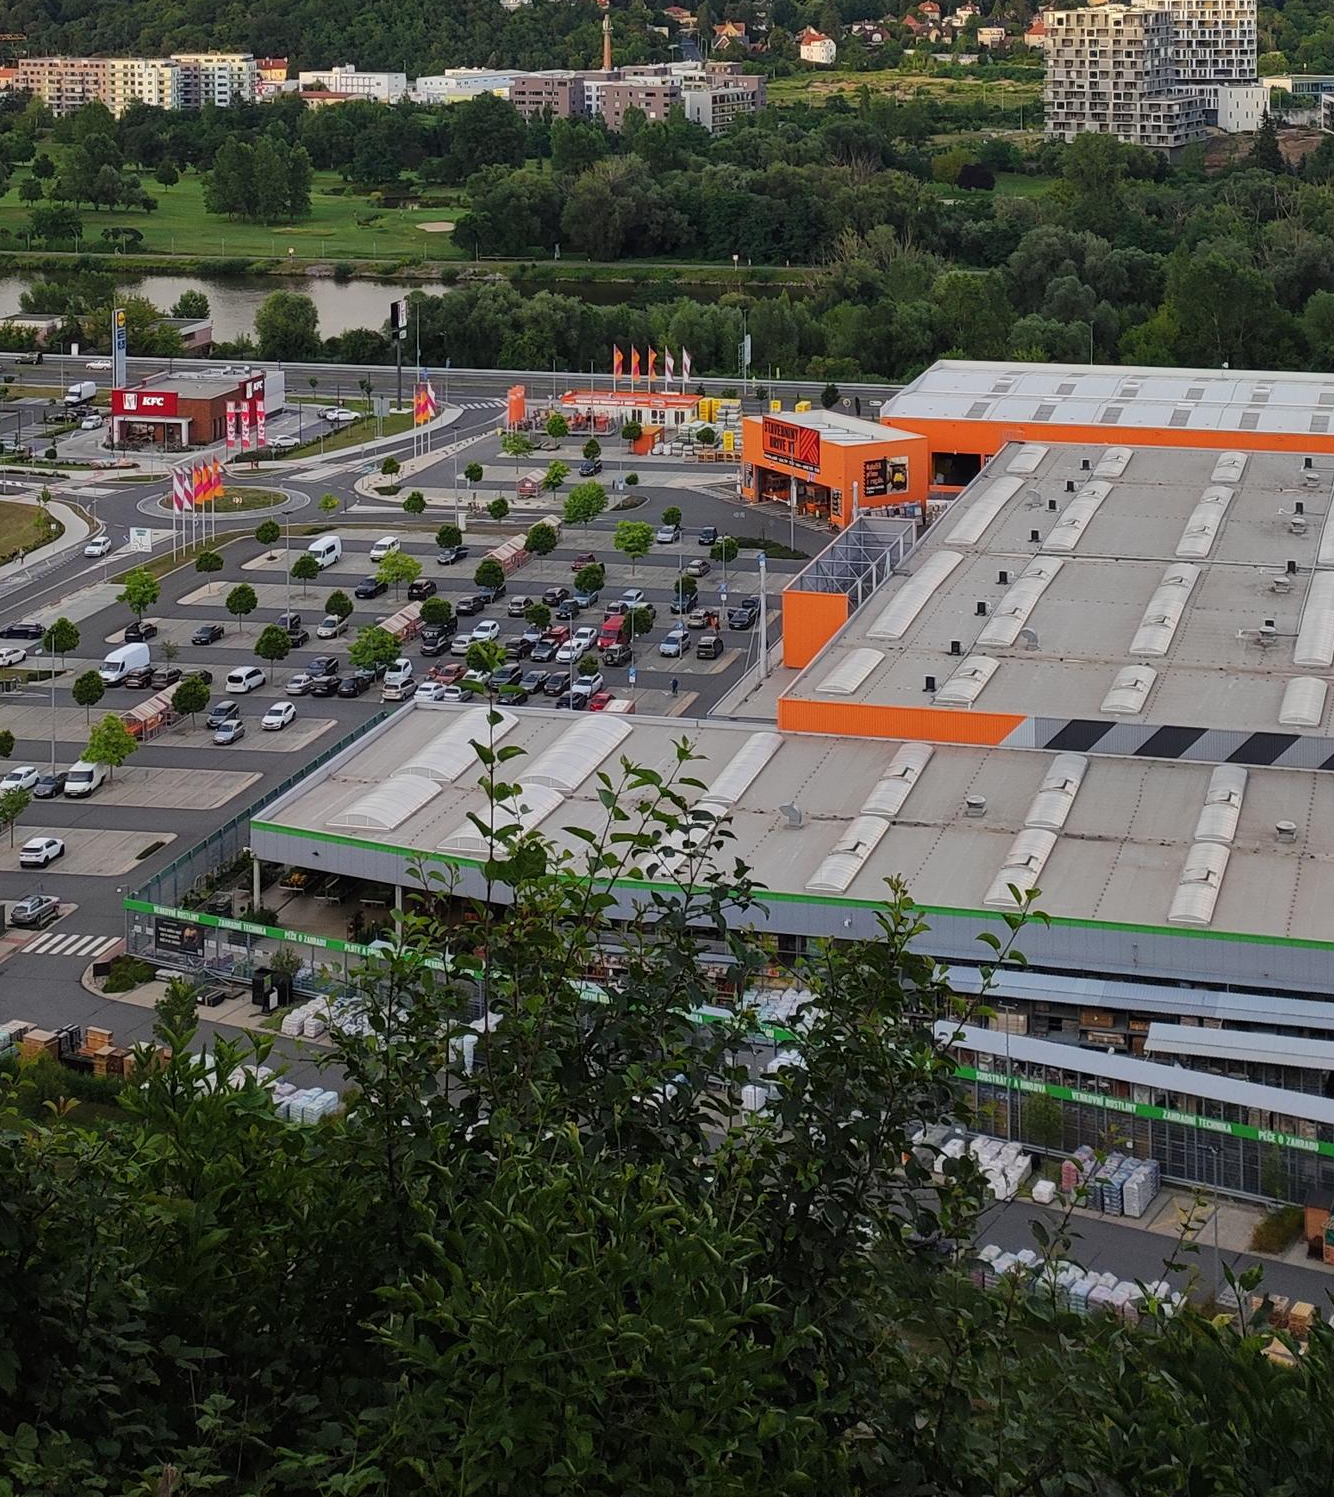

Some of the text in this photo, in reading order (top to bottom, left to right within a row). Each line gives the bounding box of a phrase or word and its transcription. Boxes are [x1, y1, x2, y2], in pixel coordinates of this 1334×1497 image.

[253, 380, 264, 391] KFC
[142, 396, 164, 406] KFC
[227, 415, 236, 441] KFC
[241, 415, 250, 441] KFC
[257, 414, 265, 440] KFC
[1198, 1117, 1232, 1134] TECHNIKA
